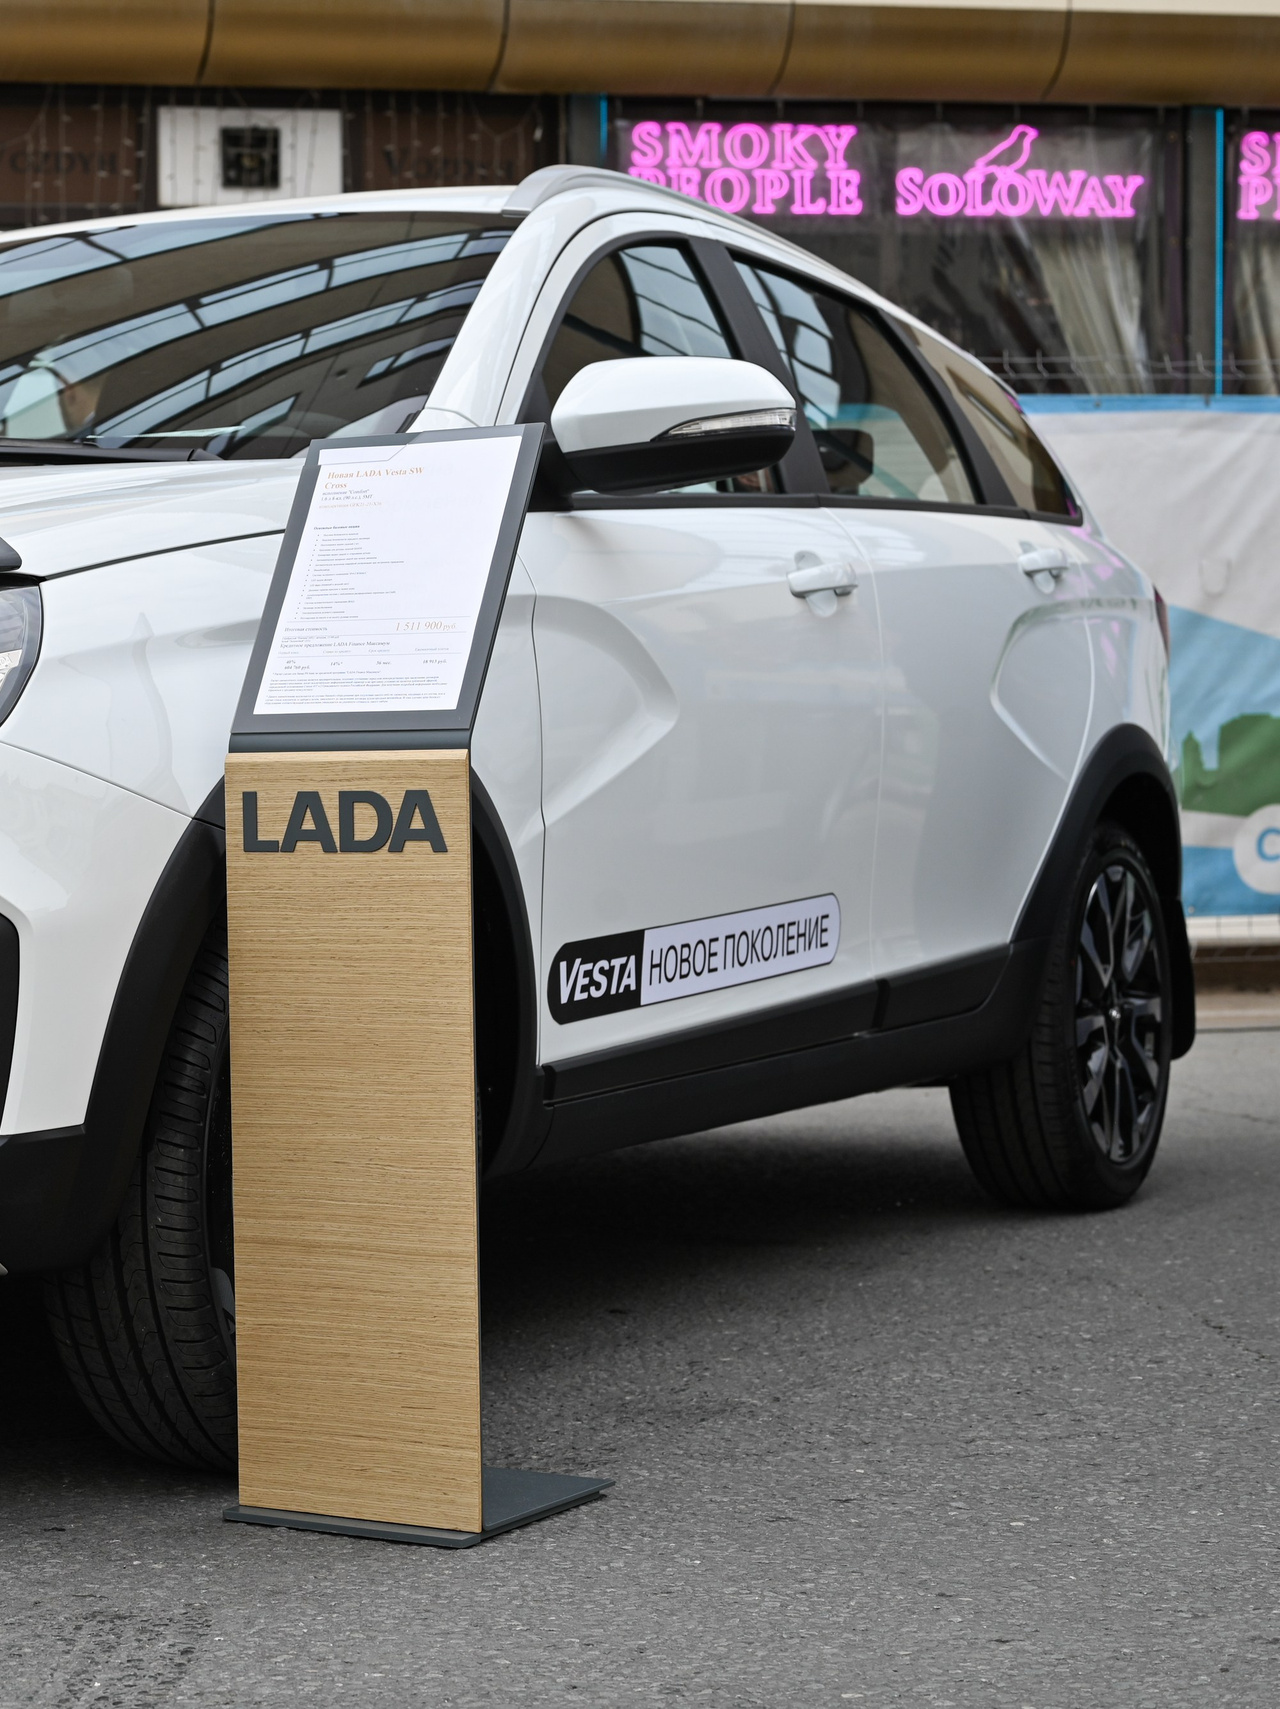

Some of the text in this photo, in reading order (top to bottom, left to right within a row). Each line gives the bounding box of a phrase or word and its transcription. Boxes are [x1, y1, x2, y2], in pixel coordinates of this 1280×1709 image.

[630, 120, 858, 171] SMOKY
[1239, 130, 1280, 175] S
[895, 167, 1144, 218] SOLOWAY
[1236, 174, 1280, 220] P
[324, 482, 348, 490] Cross
[327, 466, 425, 479] Новая LADA Vesta SW
[403, 621, 421, 631] 511
[424, 620, 443, 630] 900
[242, 790, 448, 853] LADA
[559, 914, 830, 1005] VESTA НОВОЕ ПОКОЛЕНИЕ
